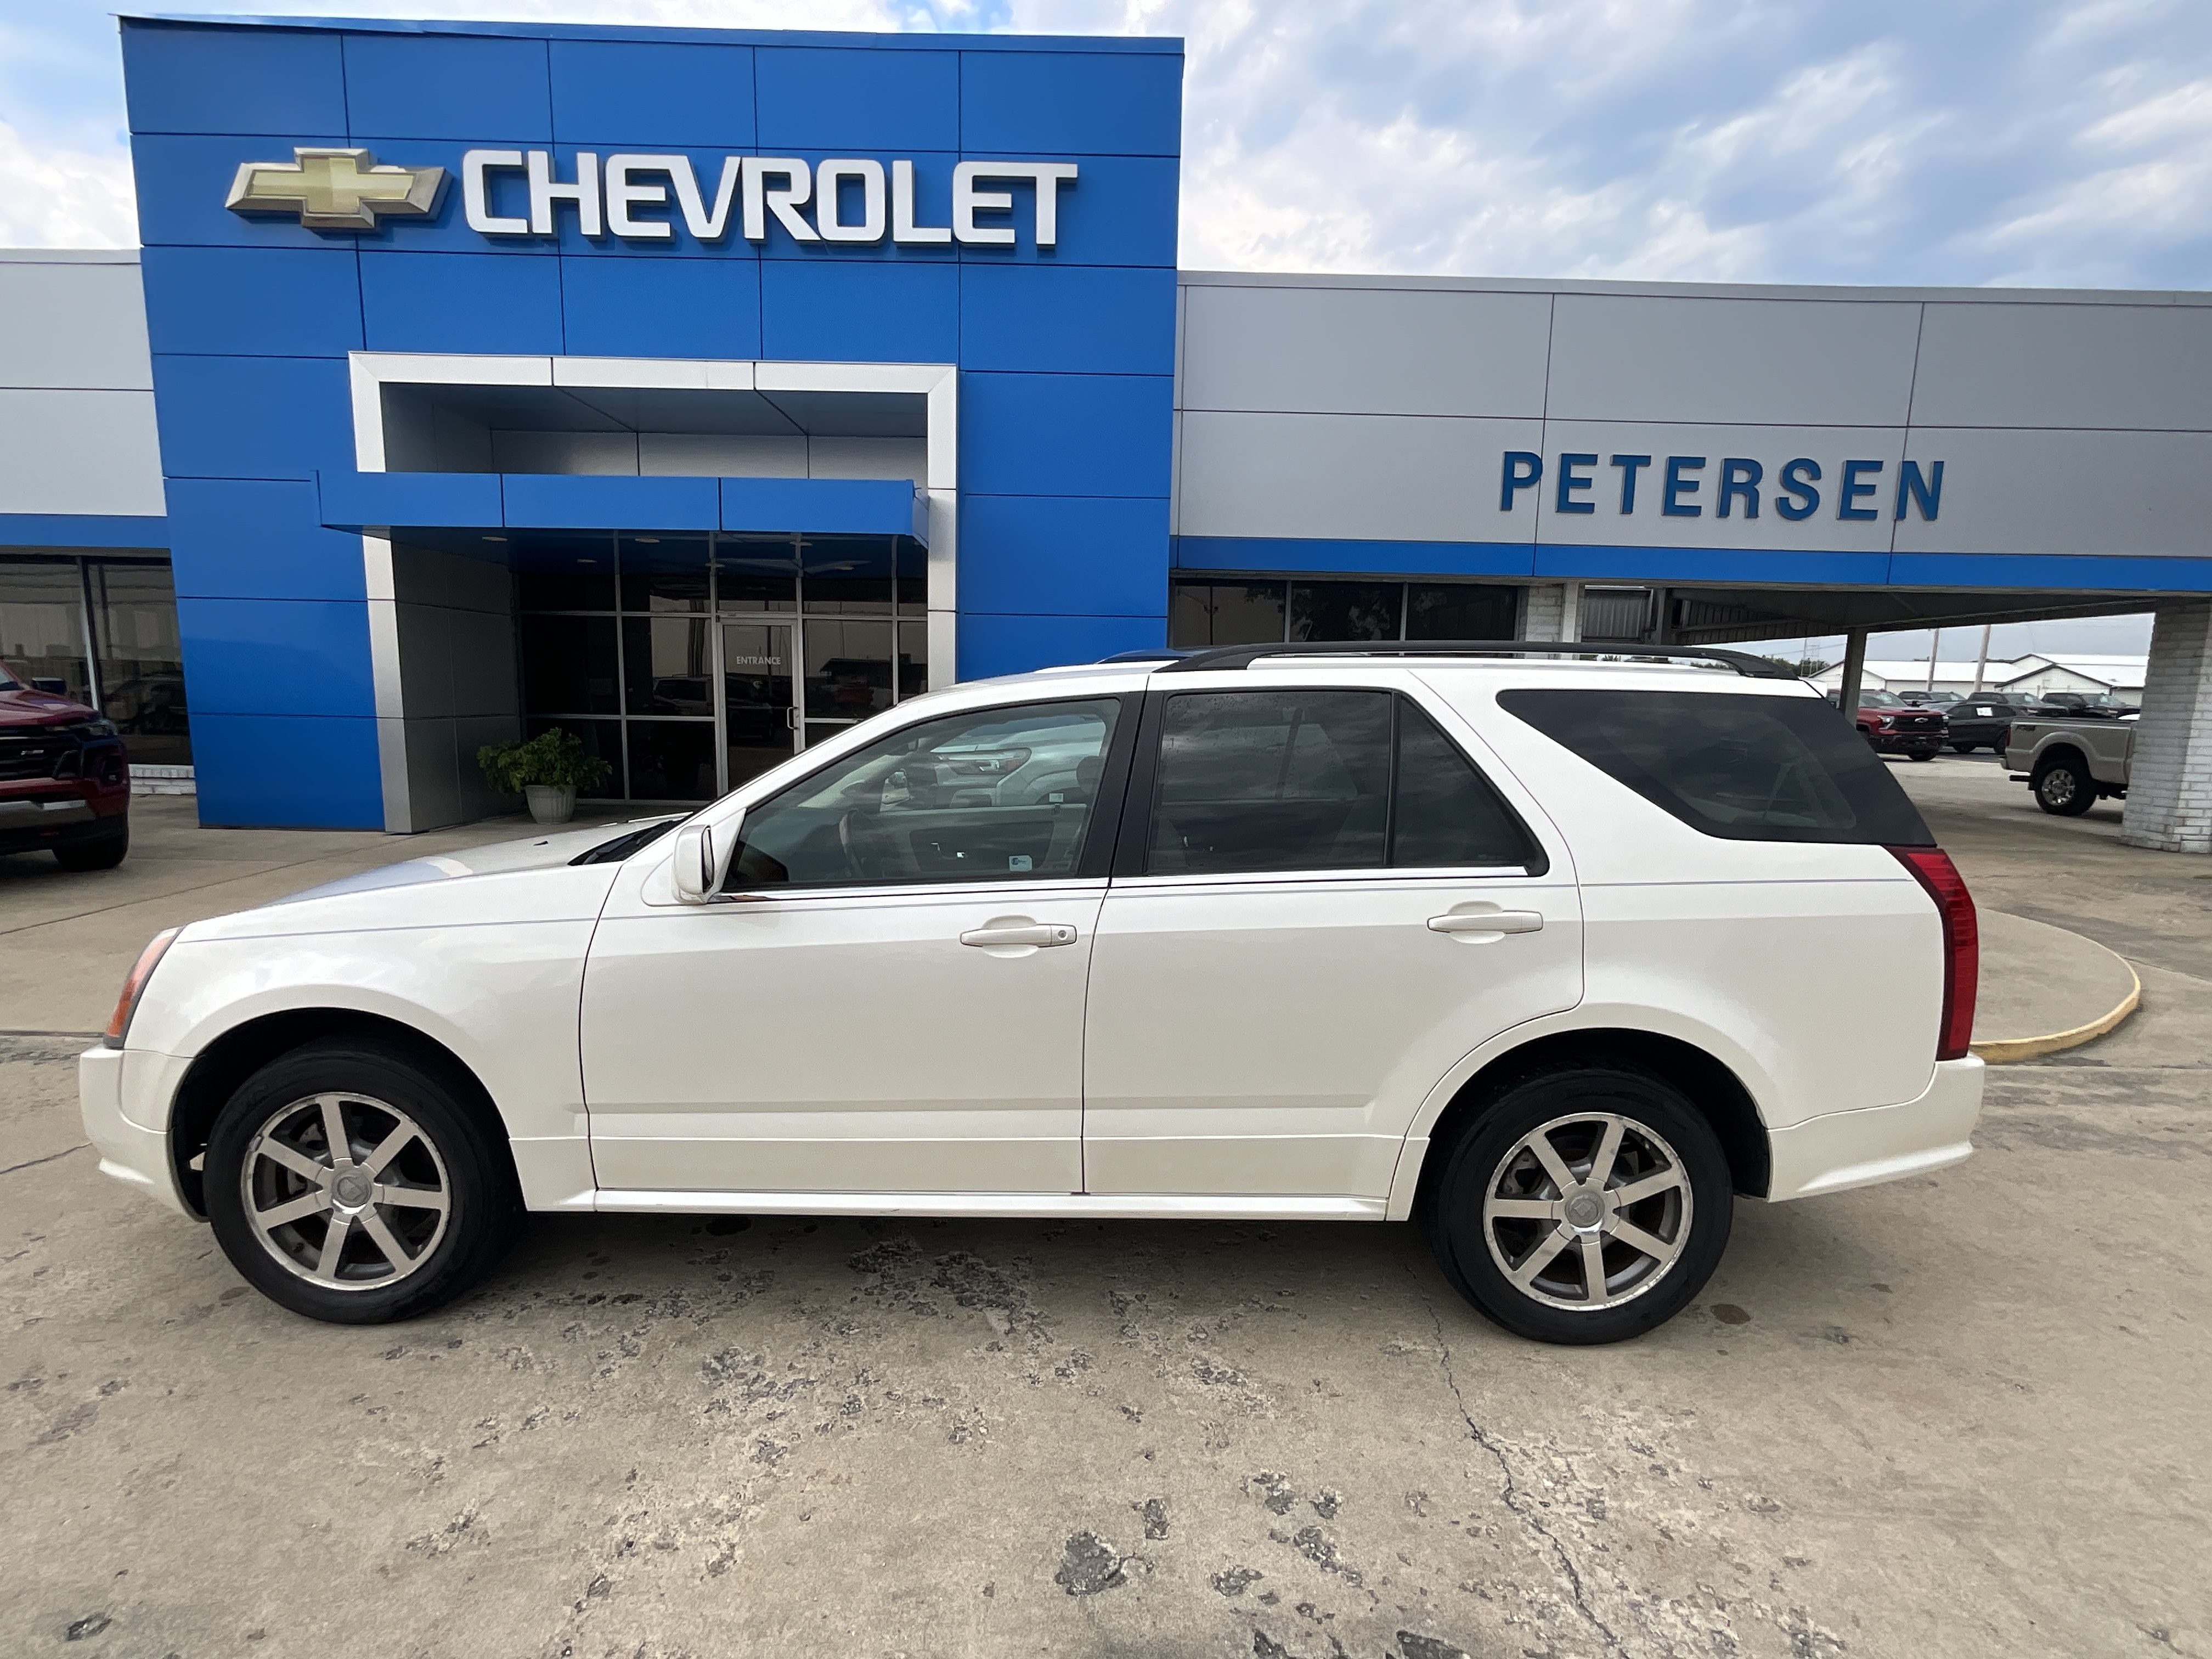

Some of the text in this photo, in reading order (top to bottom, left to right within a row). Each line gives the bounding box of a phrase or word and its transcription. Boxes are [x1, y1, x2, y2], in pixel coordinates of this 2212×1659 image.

[462, 149, 1079, 249] CHEVROLET
[1500, 451, 1944, 521] PETERSEN
[736, 656, 781, 665] ENTRANCE
